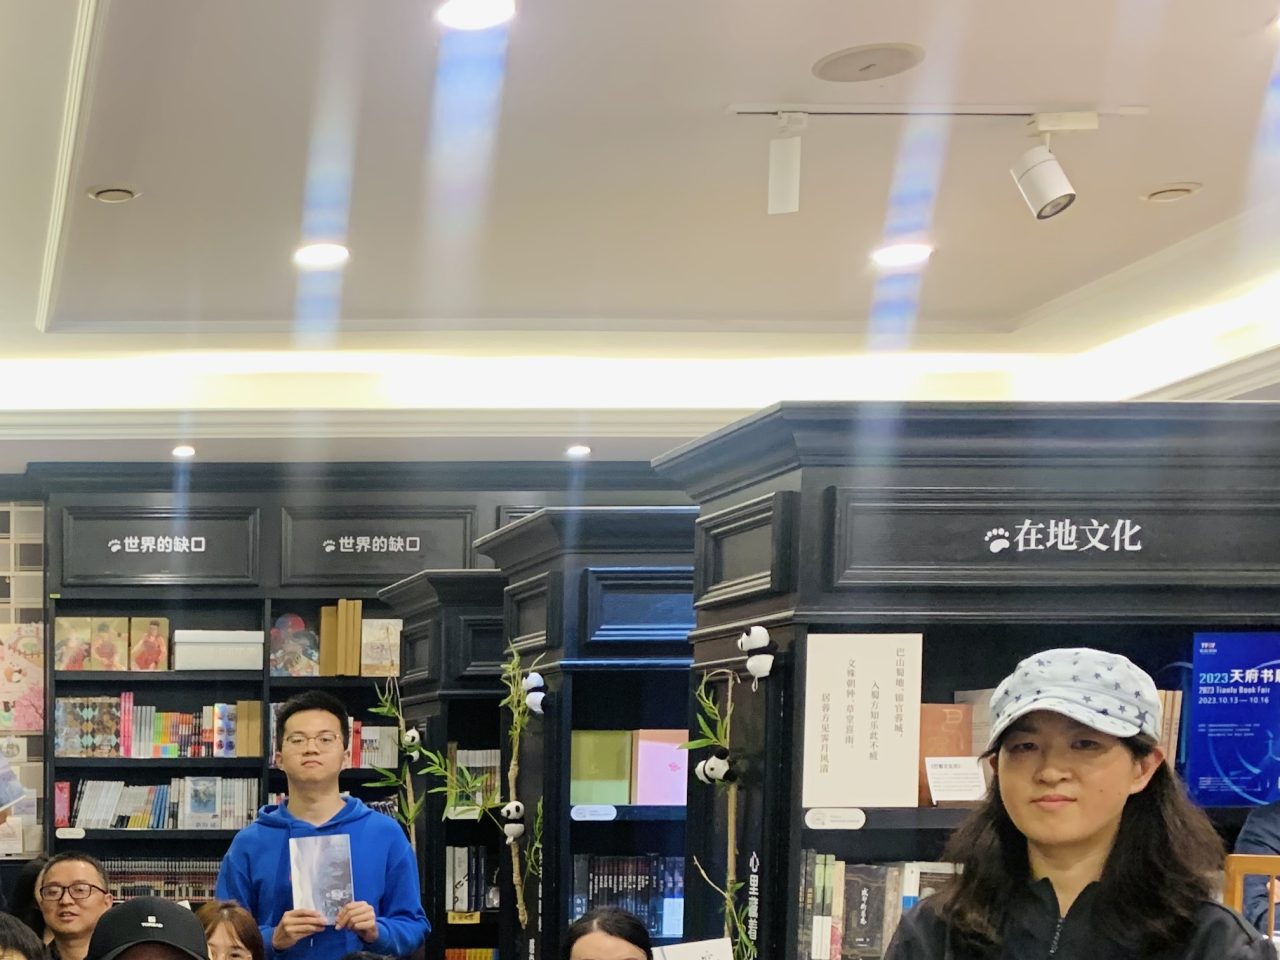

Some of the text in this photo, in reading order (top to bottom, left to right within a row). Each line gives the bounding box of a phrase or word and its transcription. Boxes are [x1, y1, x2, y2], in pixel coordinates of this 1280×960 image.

[123, 535, 207, 554] 世界的缺口
[338, 535, 421, 554] 世界的缺口
[1014, 519, 1143, 552] 在地文化
[1199, 686, 1271, 695] 2023 Tianfu Book Fair
